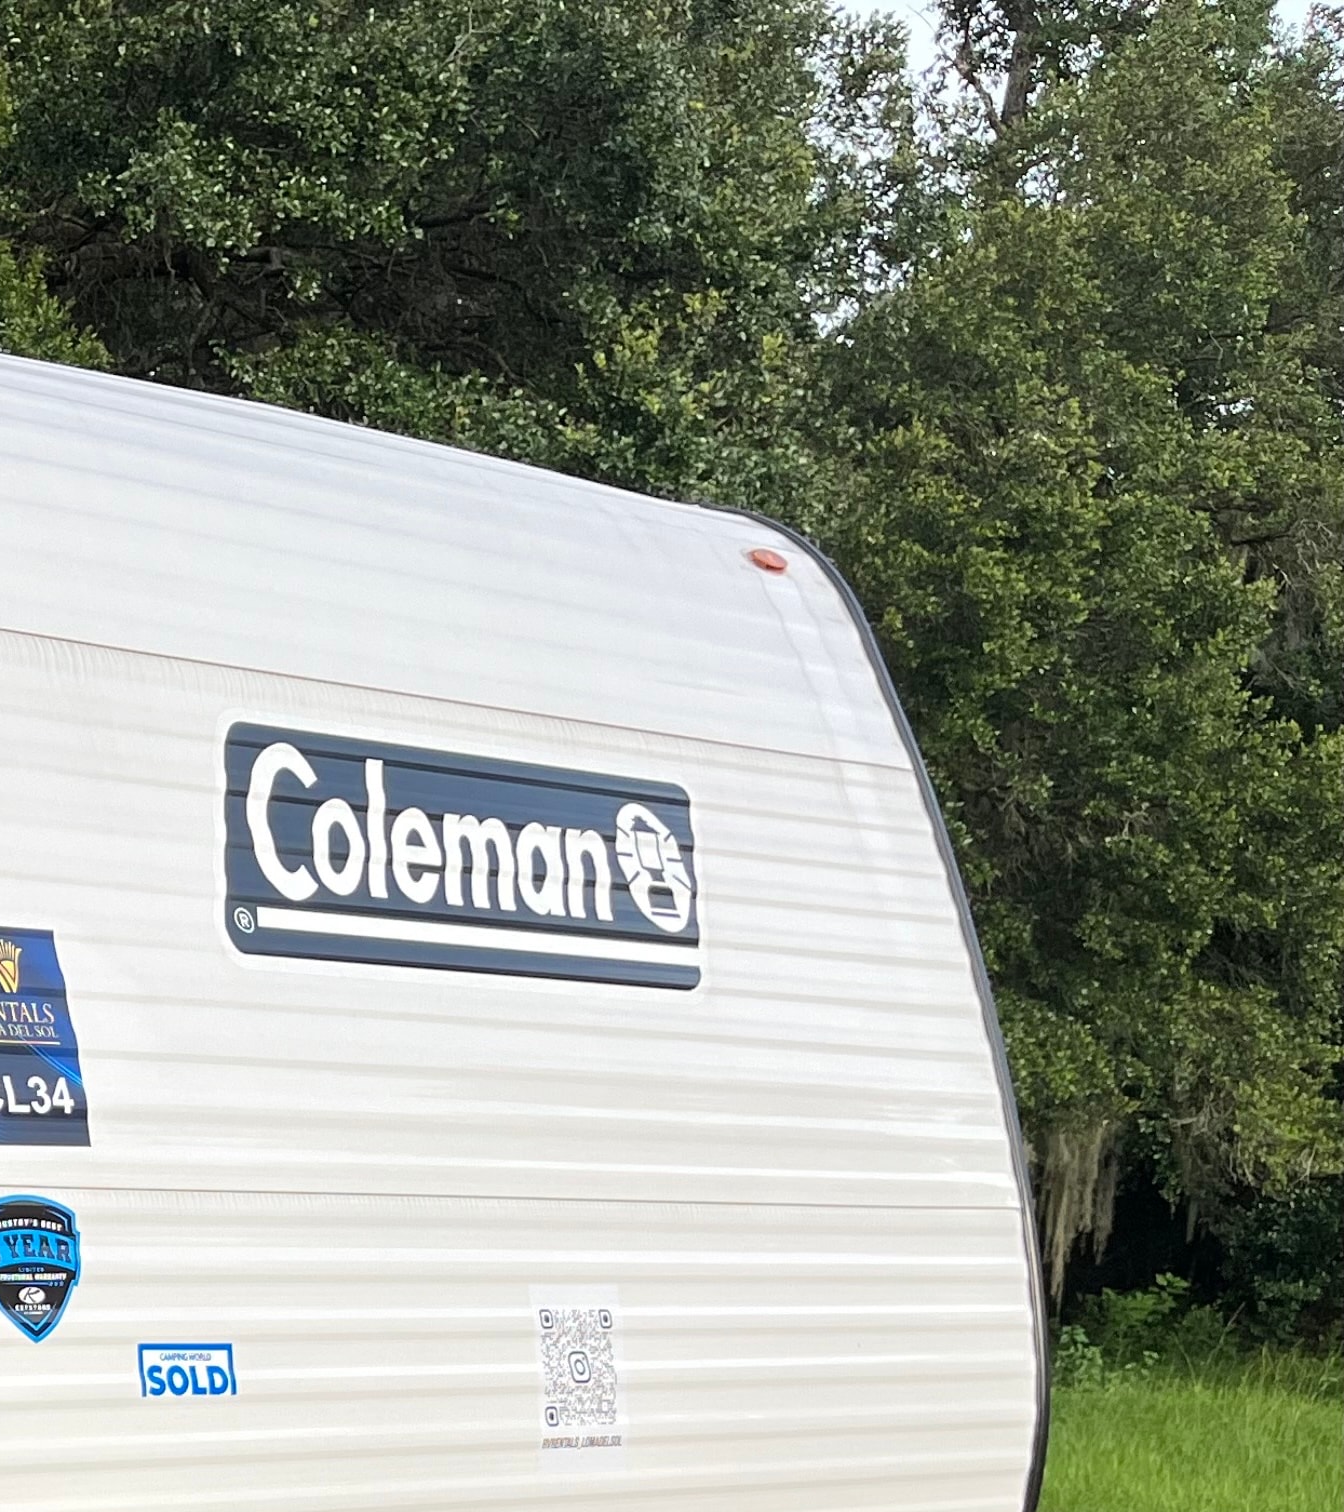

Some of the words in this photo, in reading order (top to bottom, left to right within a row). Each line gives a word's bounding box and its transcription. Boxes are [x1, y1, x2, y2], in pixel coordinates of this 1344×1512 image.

[246, 741, 613, 921] Coleman
[7, 1023, 33, 1037] DEL
[33, 1025, 60, 1038] SOL
[3, 1234, 71, 1264] YEAR
[159, 1352, 188, 1362] CAMPING
[189, 1352, 212, 1362] WORLD
[147, 1364, 229, 1396] SOLD
